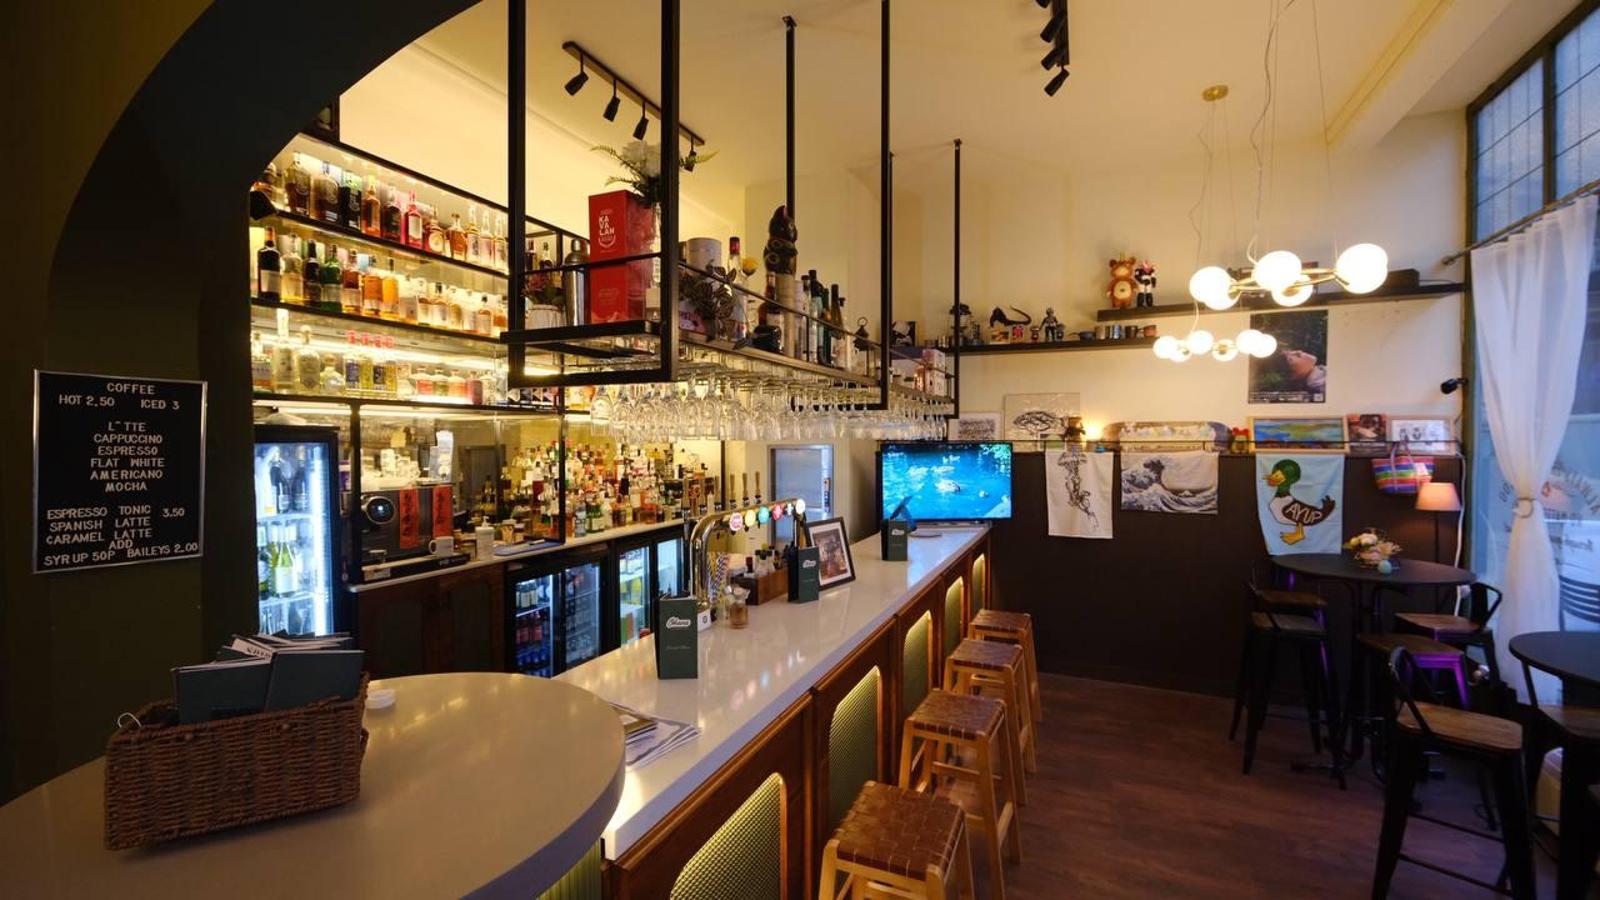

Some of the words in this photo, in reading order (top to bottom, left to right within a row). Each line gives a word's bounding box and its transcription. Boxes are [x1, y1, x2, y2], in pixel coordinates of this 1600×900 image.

[107, 383, 156, 394] COFFEE
[60, 395, 81, 405] HOT
[87, 396, 114, 406] 2.50
[141, 400, 166, 409] ICED
[173, 401, 179, 409] 3
[94, 434, 162, 443] CAPPUCCINO
[98, 446, 158, 455] ESPRESSO
[91, 459, 119, 467] FLAT
[131, 458, 164, 466] WHITE
[91, 470, 162, 479] AMERICANO
[106, 482, 147, 492] MOCHA
[48, 508, 107, 519] ESPRESSO
[120, 505, 150, 515] TONIC
[163, 508, 184, 517] 3.50
[50, 520, 103, 531] SPANISH
[116, 517, 150, 527] LATTE
[47, 532, 104, 544] CARAMEL
[115, 529, 152, 540] LATTE
[109, 539, 133, 550] ADD
[45, 553, 88, 565] SYRUP
[93, 551, 115, 560] 50P
[127, 545, 171, 558] BAILEYS
[174, 543, 198, 552] 2.00
